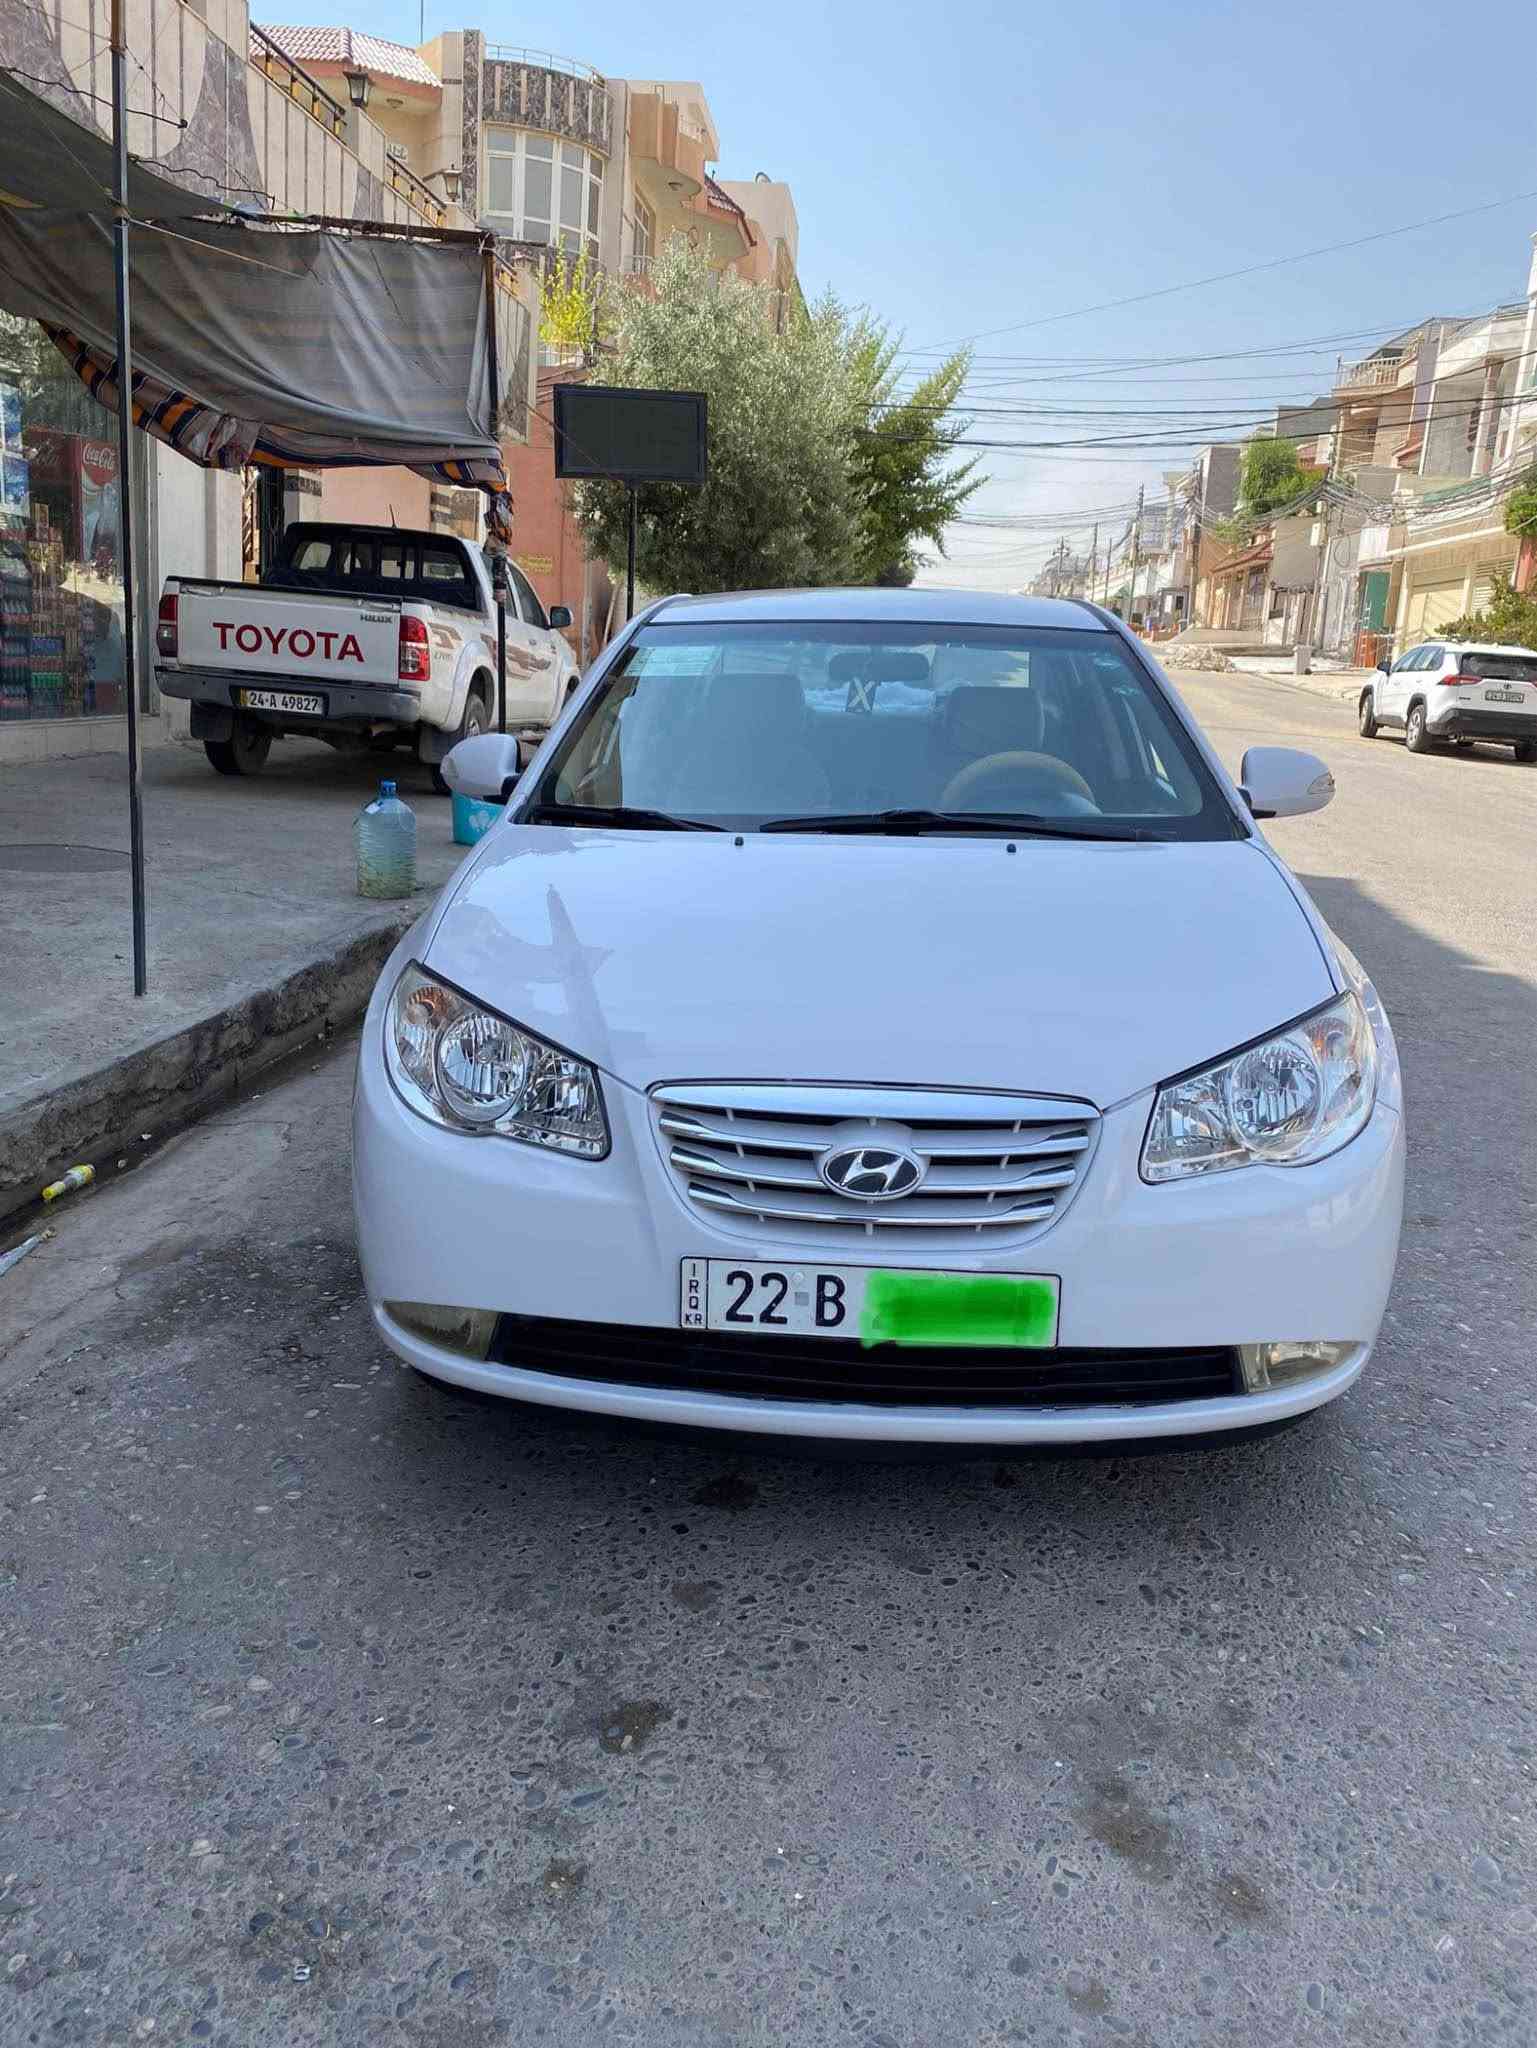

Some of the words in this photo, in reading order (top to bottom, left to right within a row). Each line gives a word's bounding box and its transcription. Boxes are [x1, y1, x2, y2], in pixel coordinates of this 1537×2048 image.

[213, 622, 365, 663] TOYOTA
[281, 695, 318, 712] 49827
[725, 1270, 788, 1325] 22
[815, 1274, 846, 1327] B
